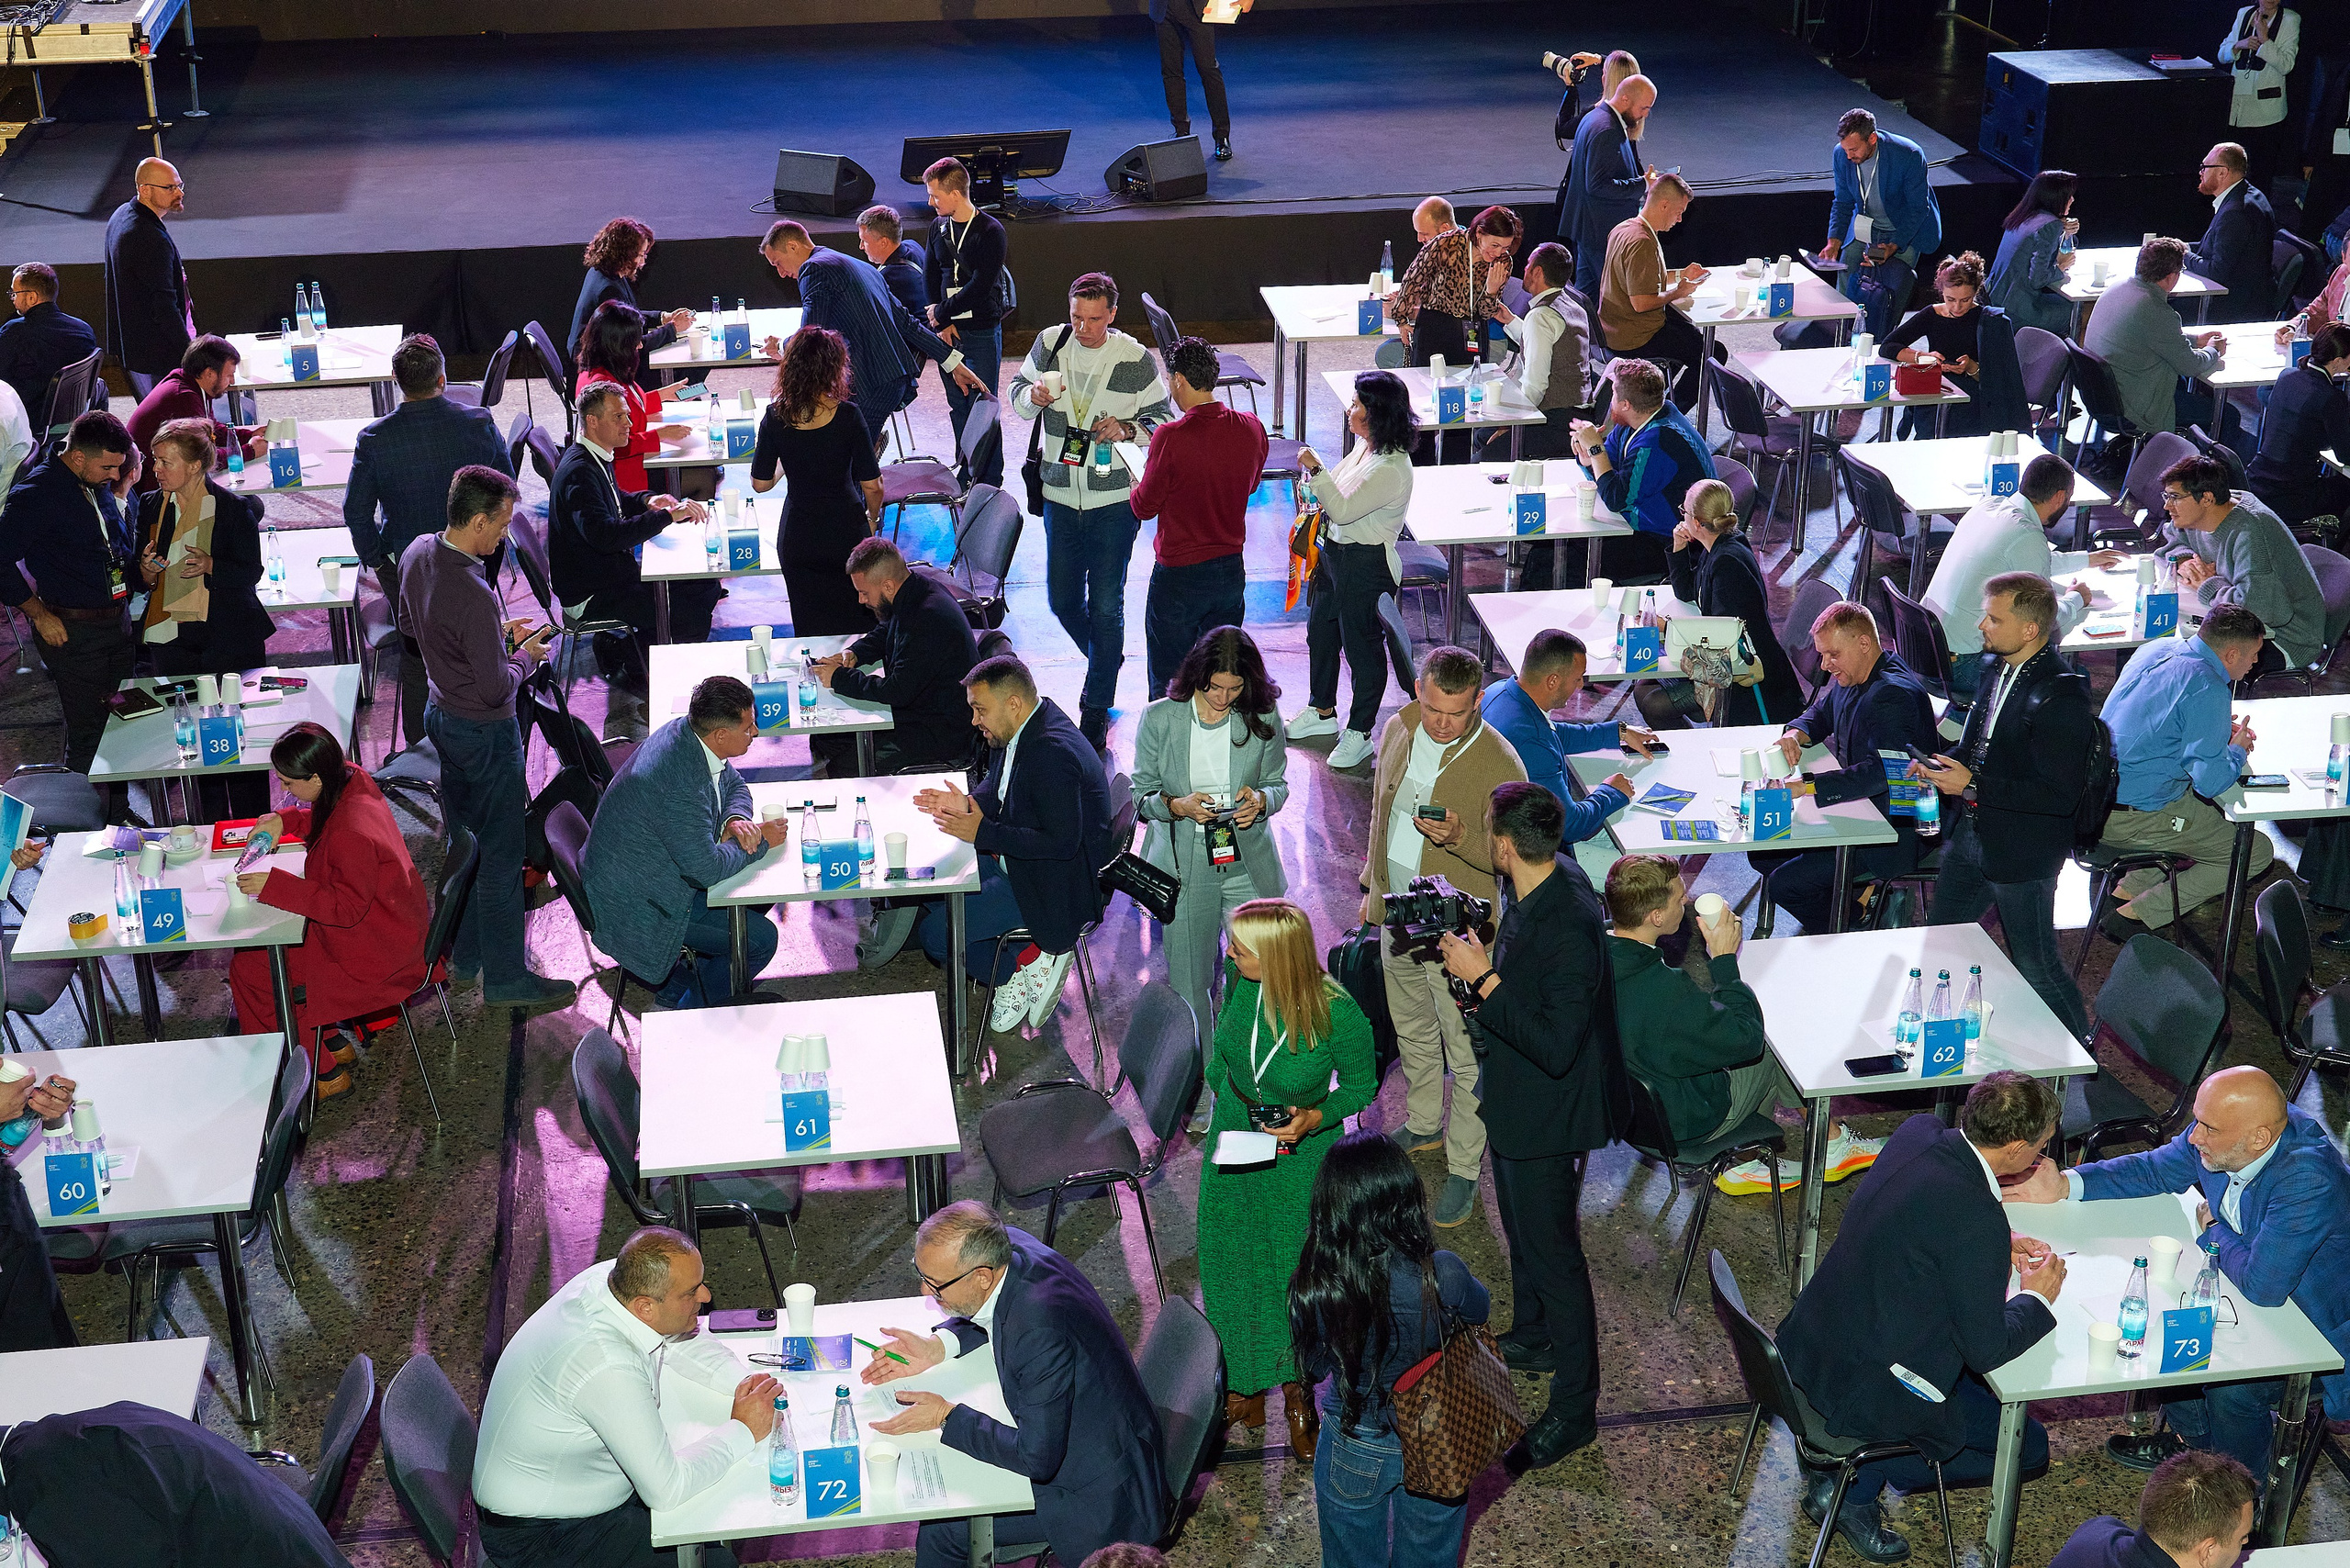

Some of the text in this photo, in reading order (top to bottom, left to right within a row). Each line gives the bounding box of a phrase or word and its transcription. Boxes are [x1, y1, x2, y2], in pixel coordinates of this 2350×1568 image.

[1778, 297, 1785, 308] 8
[1367, 315, 1375, 326] 7
[734, 339, 743, 350] 6
[302, 361, 309, 371] 5
[1872, 380, 1886, 392] 19
[1446, 402, 1460, 414] 18
[734, 435, 749, 447] 17
[279, 465, 295, 477] 16
[1998, 481, 2013, 493] 30
[1523, 510, 1539, 524] 29
[735, 547, 753, 560] 28
[2153, 613, 2169, 627] 41
[1633, 647, 1652, 661] 40
[762, 702, 782, 717] 39
[210, 739, 230, 753] 38
[1762, 815, 1780, 827] 51
[829, 861, 851, 878] 50
[151, 913, 174, 928] 49
[1932, 1046, 1955, 1063] 62
[795, 1118, 816, 1137] 61
[59, 1182, 85, 1201] 60
[2174, 1338, 2199, 1358] 73
[840, 1359, 848, 1367] 20
[818, 1480, 847, 1501] 72
